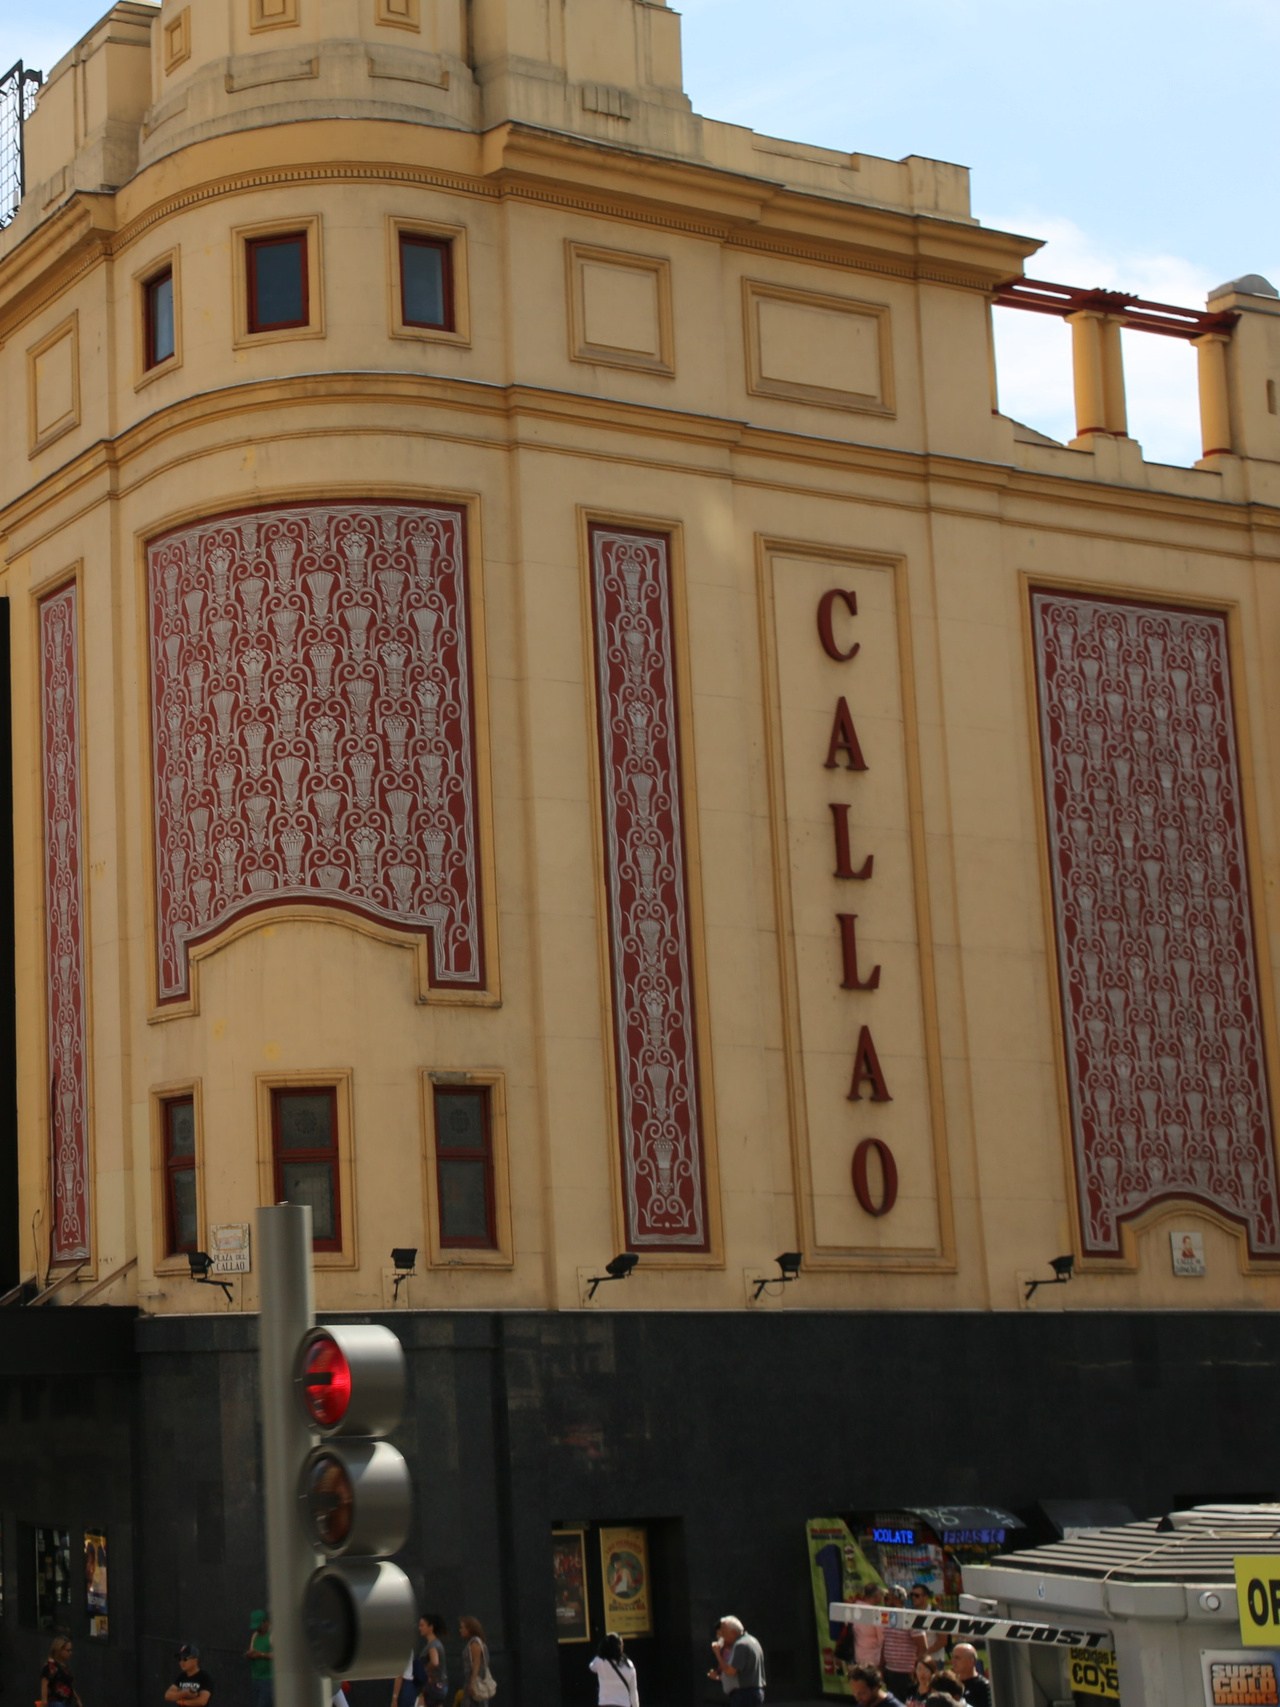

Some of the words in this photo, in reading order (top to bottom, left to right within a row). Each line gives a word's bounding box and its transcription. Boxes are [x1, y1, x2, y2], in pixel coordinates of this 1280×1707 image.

[816, 587, 900, 1218] CALLAO
[216, 1261, 245, 1272] CALLAO
[912, 1615, 996, 1636] LOW
[1006, 1624, 1108, 1648] COST
[1211, 1664, 1273, 1679] SUPER
[1212, 1677, 1278, 1694] COLD
[1213, 1692, 1280, 1706] DRINKS
